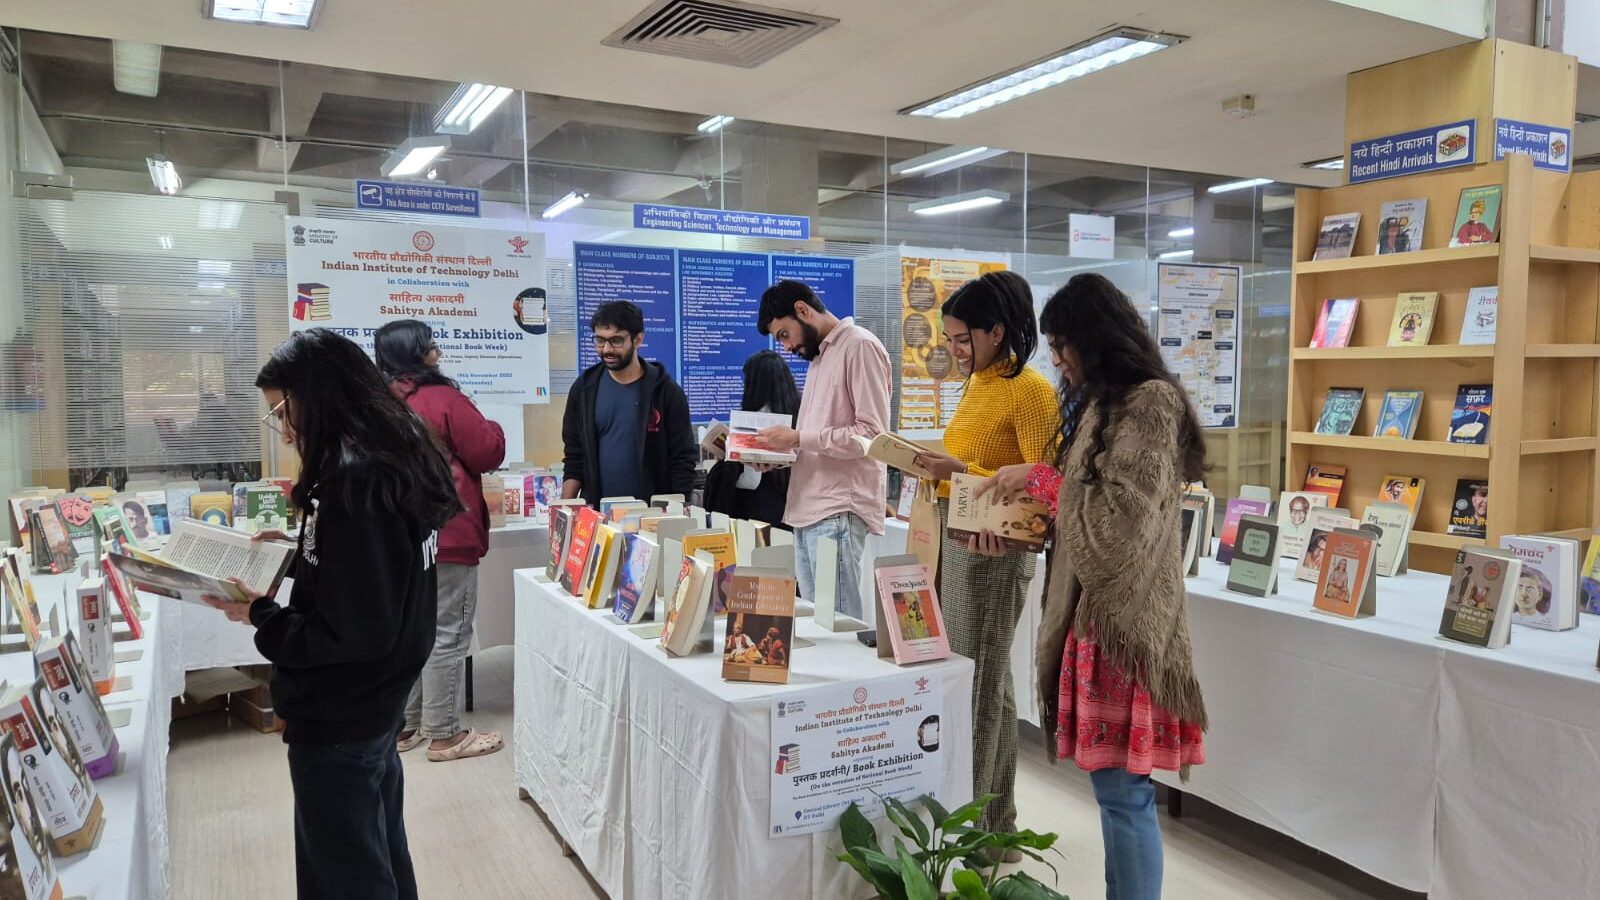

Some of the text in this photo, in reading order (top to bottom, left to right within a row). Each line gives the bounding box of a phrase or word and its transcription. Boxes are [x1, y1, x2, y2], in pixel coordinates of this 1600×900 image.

[1353, 135, 1434, 160] नये हिन्दी प्रकाशन
[1352, 152, 1433, 177] Recent Hindi Arrivals
[432, 202, 444, 210] CCTV
[642, 217, 681, 229] Engineering
[716, 222, 750, 234] Technology
[751, 225, 762, 234] and
[764, 226, 802, 236] Management
[353, 250, 492, 266] भारतीय प्रौद्योगिकी संस्थान दिल्ली
[322, 261, 519, 278] Indian Institute of Technology Delhi
[397, 278, 450, 287] Collaboration
[452, 280, 470, 288] with
[389, 291, 465, 304] साहित्य अकादमी
[380, 305, 477, 317] Sahitya Akademi
[432, 328, 523, 340] ok Exhibition
[485, 343, 508, 352] Week)
[957, 486, 969, 518] PARVA
[731, 599, 753, 610] Indian
[795, 722, 820, 732] Indian
[821, 717, 854, 728] Institute
[864, 708, 904, 720] Technology
[905, 704, 923, 713] Delhi
[831, 740, 895, 759] Sahitya Akademi
[853, 752, 924, 773] Book Exhibition
[793, 771, 818, 787] पुस्तक
[810, 782, 821, 791] (On
[821, 780, 831, 788] the
[832, 777, 855, 787] occasion
[862, 770, 884, 780] National
